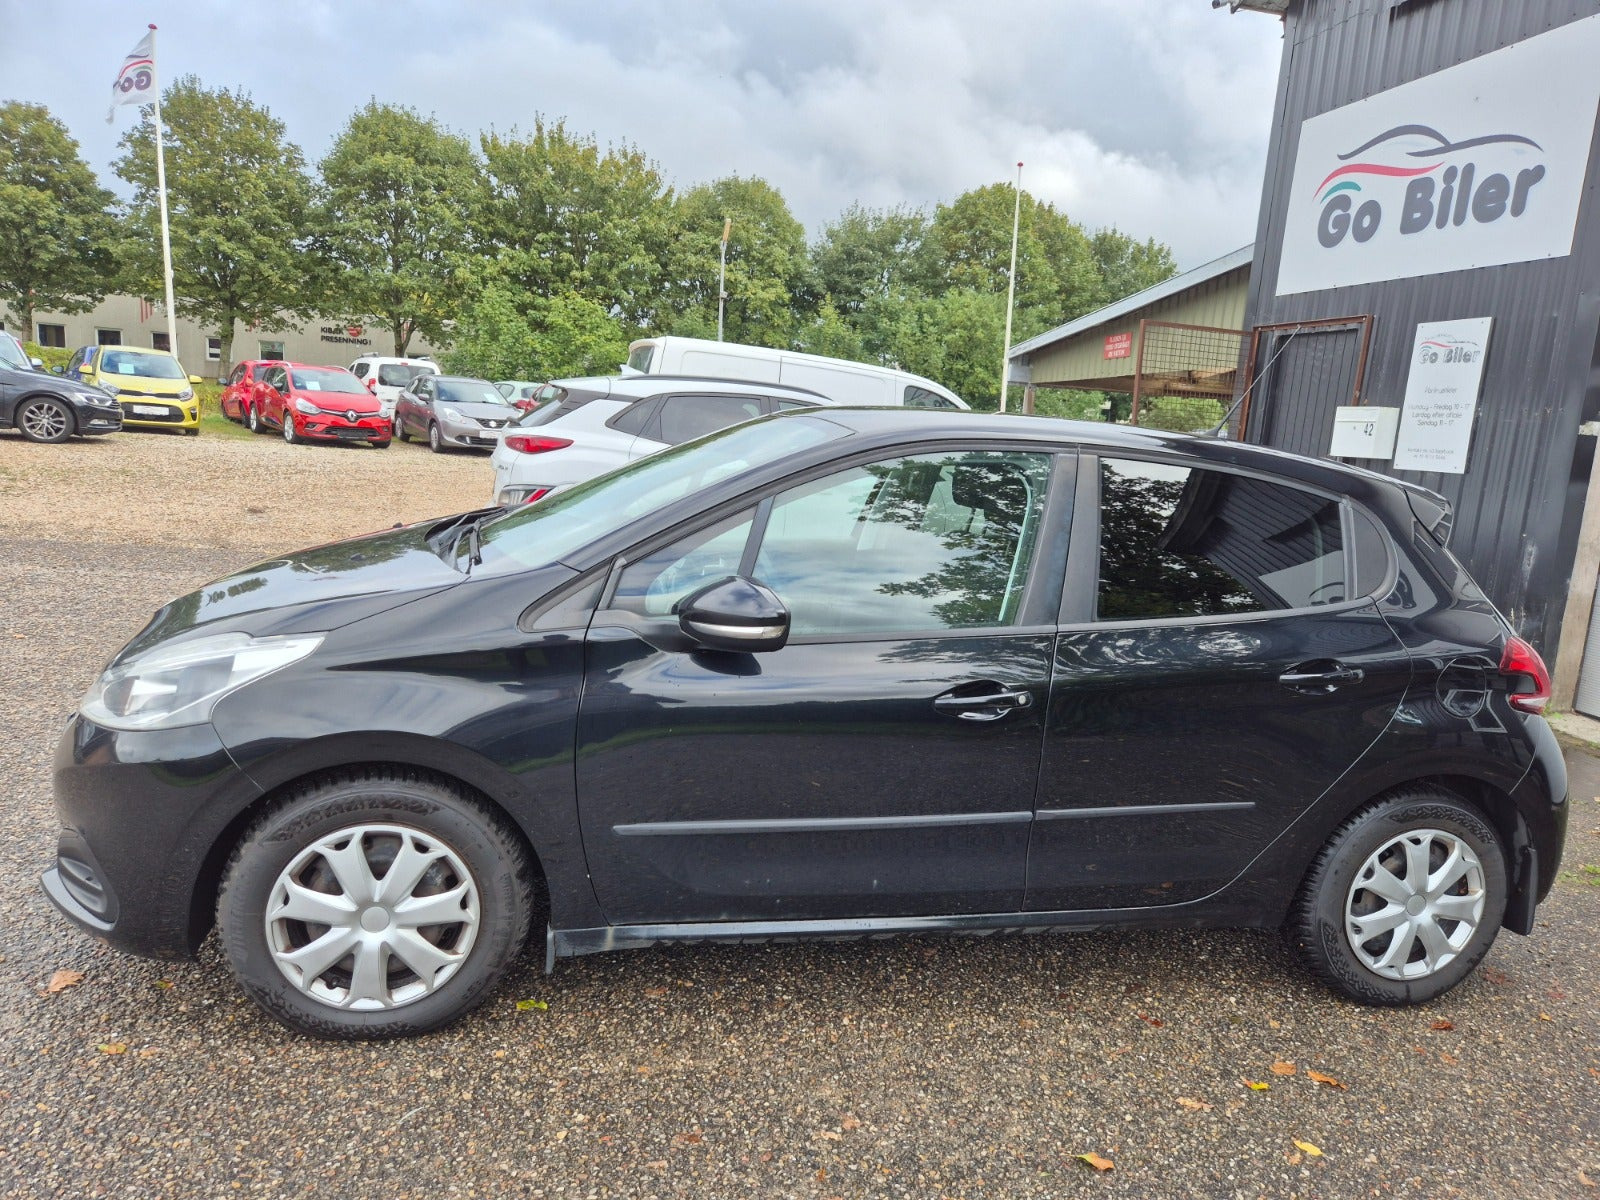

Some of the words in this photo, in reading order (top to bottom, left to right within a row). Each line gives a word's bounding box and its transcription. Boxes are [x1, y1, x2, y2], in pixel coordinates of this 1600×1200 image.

[1316, 193, 1382, 249] Go
[1399, 162, 1546, 235] Biler
[320, 335, 368, 345] PRESENNING
[1419, 348, 1439, 364] Go
[1442, 346, 1481, 364] Biler
